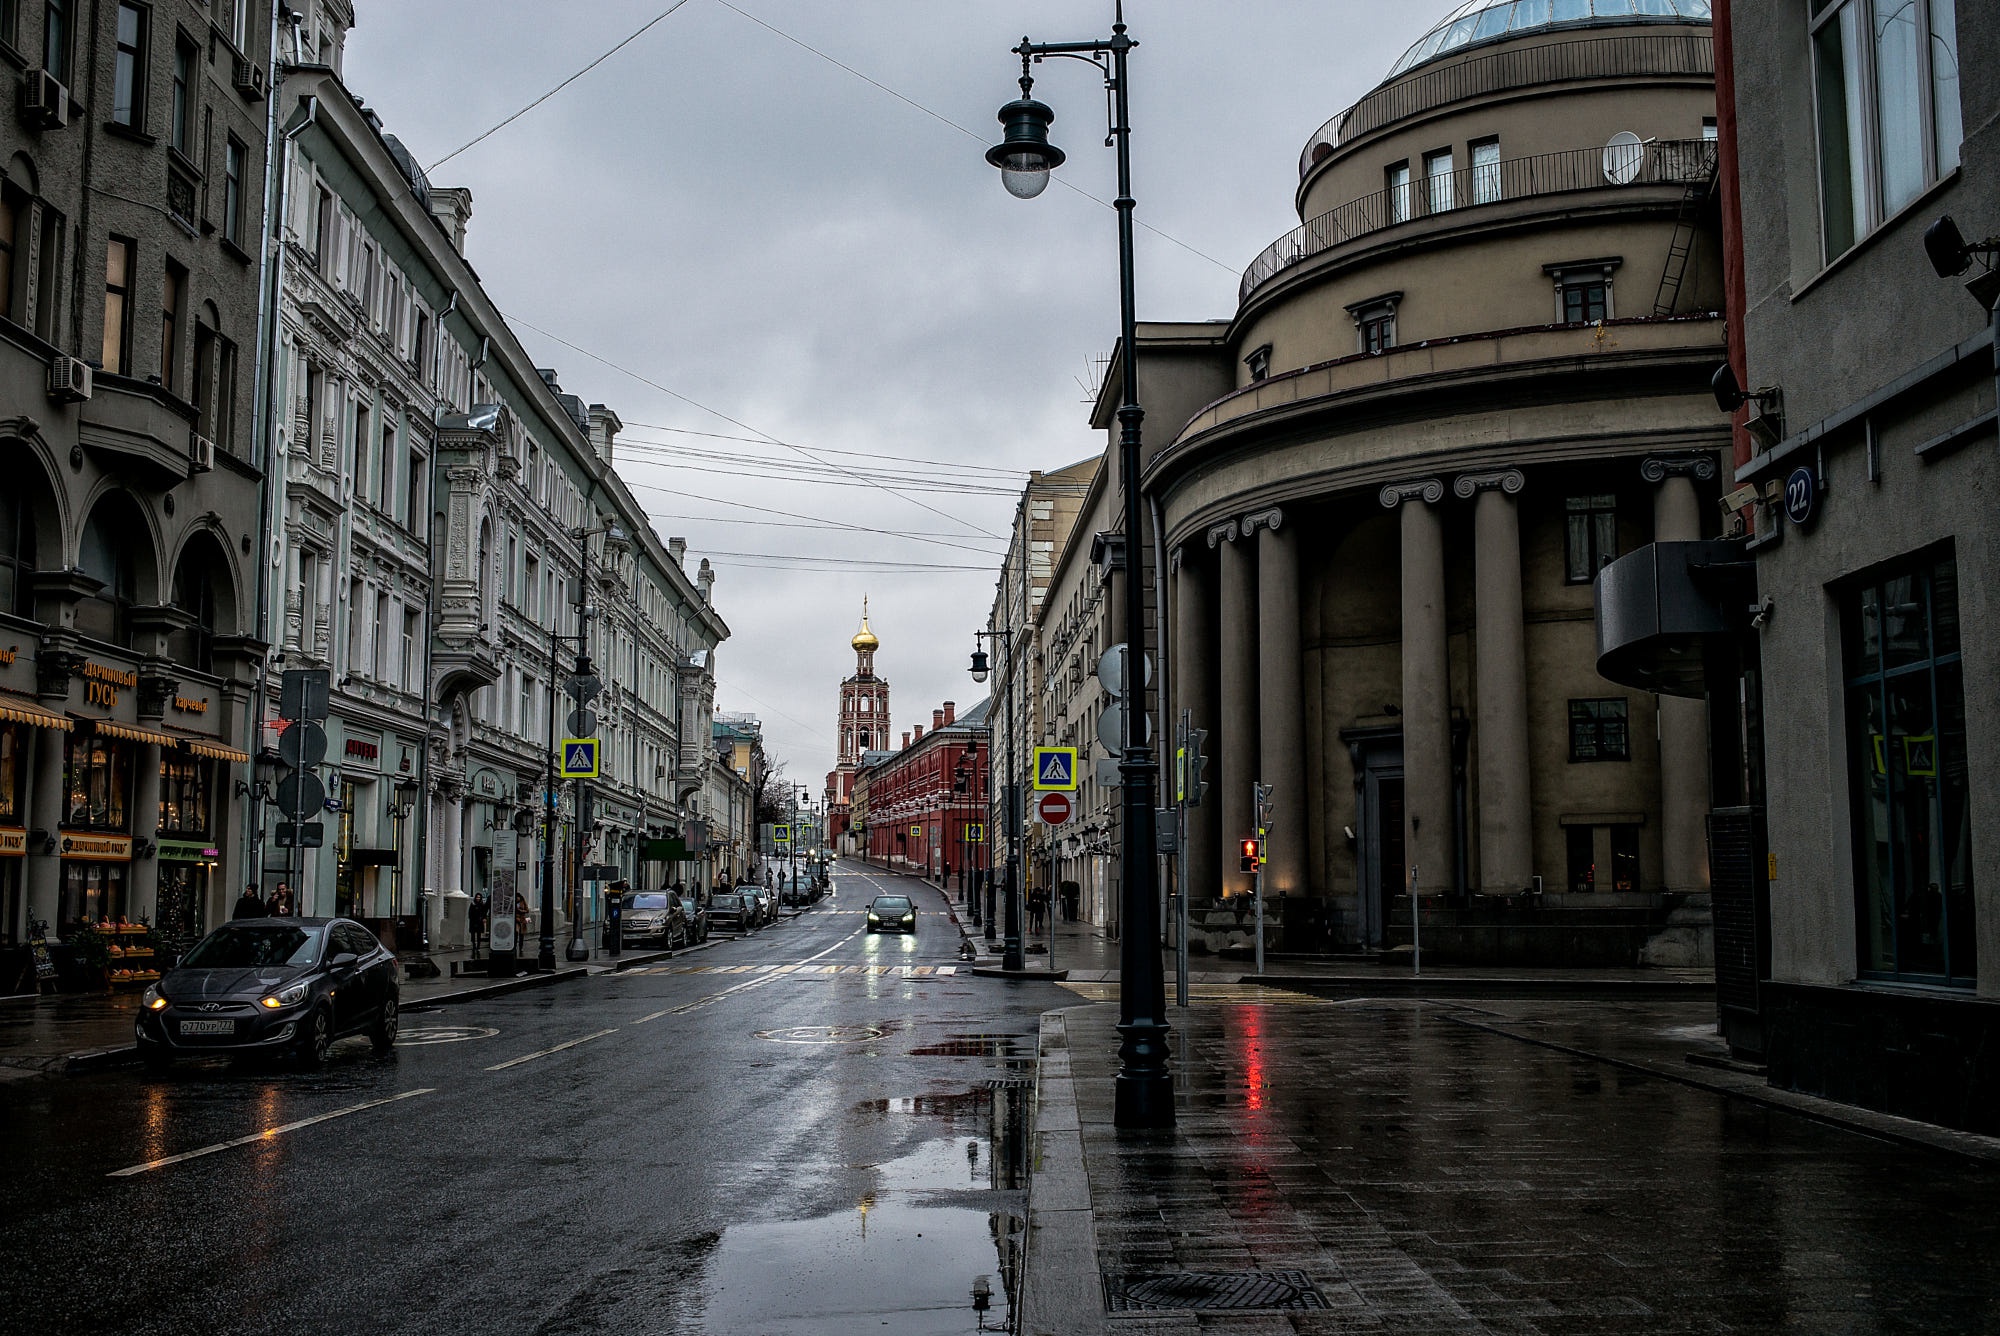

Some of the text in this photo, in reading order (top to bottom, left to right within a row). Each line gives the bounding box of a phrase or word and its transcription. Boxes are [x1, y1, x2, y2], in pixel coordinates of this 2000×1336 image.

[1789, 478, 1807, 513] 22
[346, 738, 378, 759] АПТЕКА
[1250, 856, 1259, 872] 2
